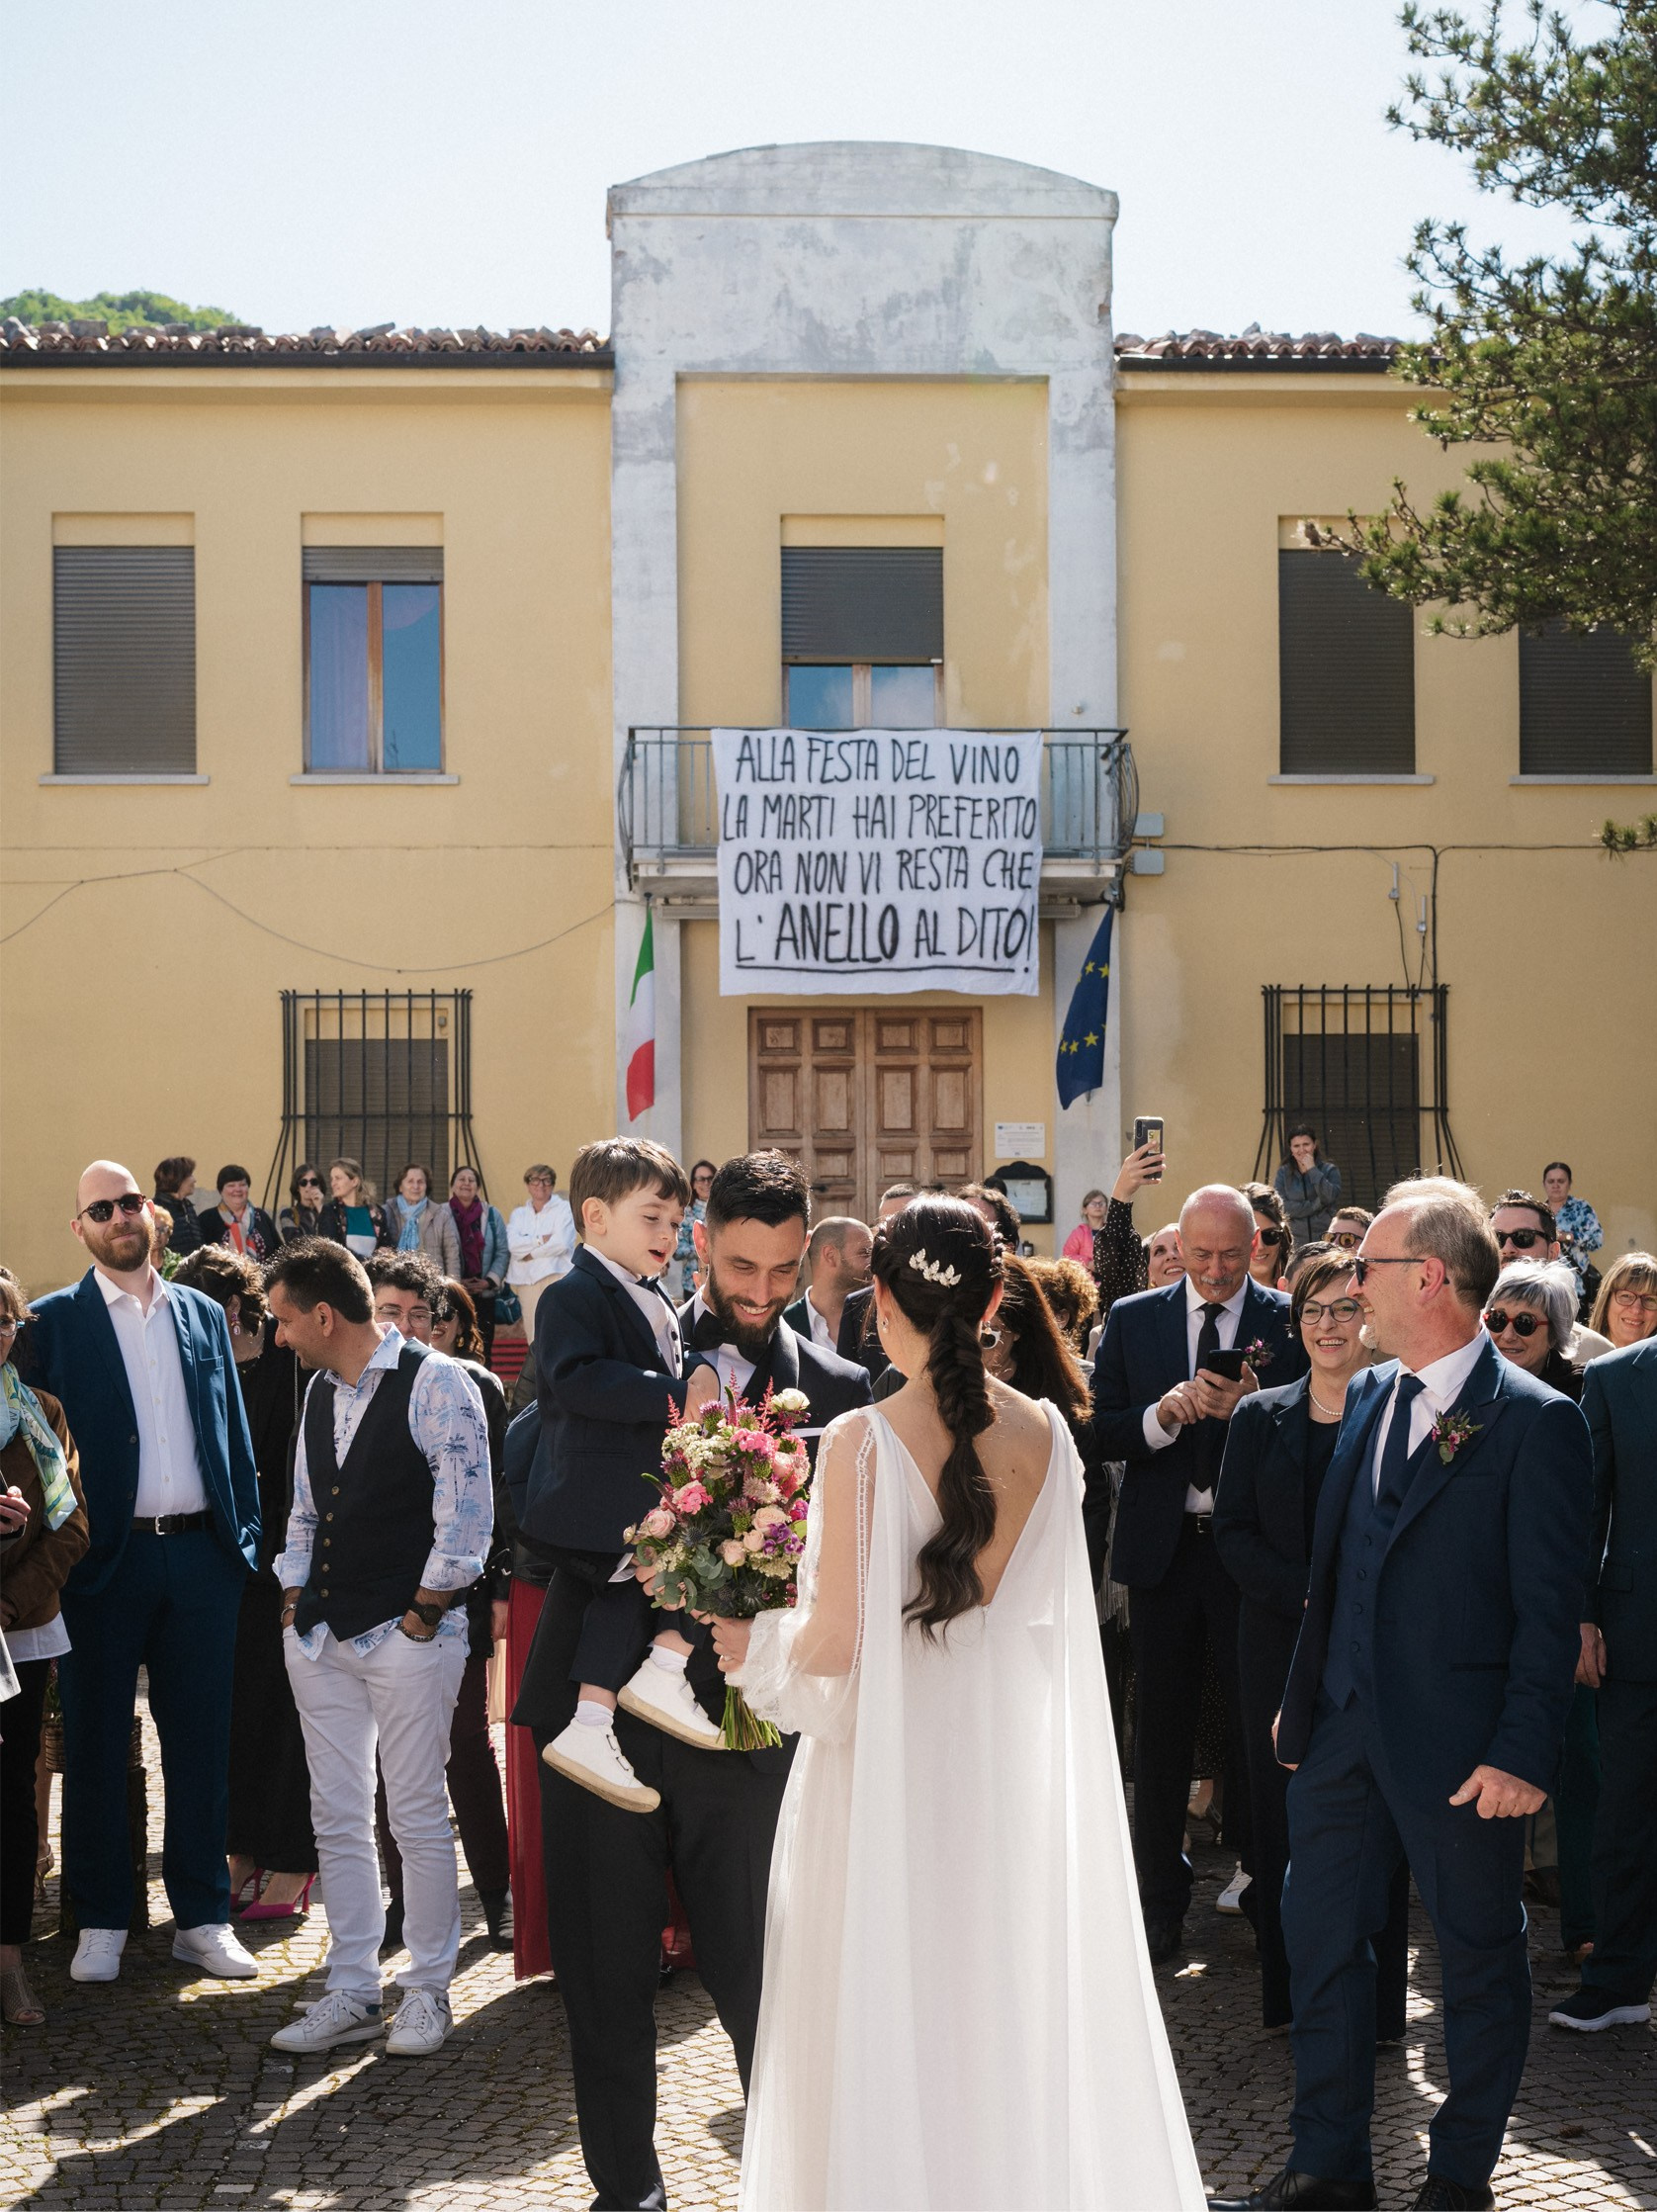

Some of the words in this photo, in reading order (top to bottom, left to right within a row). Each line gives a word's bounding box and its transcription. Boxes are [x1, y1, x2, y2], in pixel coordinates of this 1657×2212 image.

[736, 736, 796, 783] ALLA
[807, 738, 879, 783] FESTA
[892, 739, 935, 782] DEL
[950, 744, 1019, 784] VINO
[723, 794, 747, 841] LA
[760, 794, 835, 841] MARTI
[852, 795, 895, 840] HAI
[909, 795, 1036, 840] PREFERITO
[735, 850, 782, 895] ORA
[795, 851, 846, 895] NON
[859, 851, 880, 893] VI
[897, 845, 969, 891] RESTA
[983, 848, 1034, 891] CHE
[914, 910, 946, 958] AL
[957, 905, 1035, 973] DITO!
